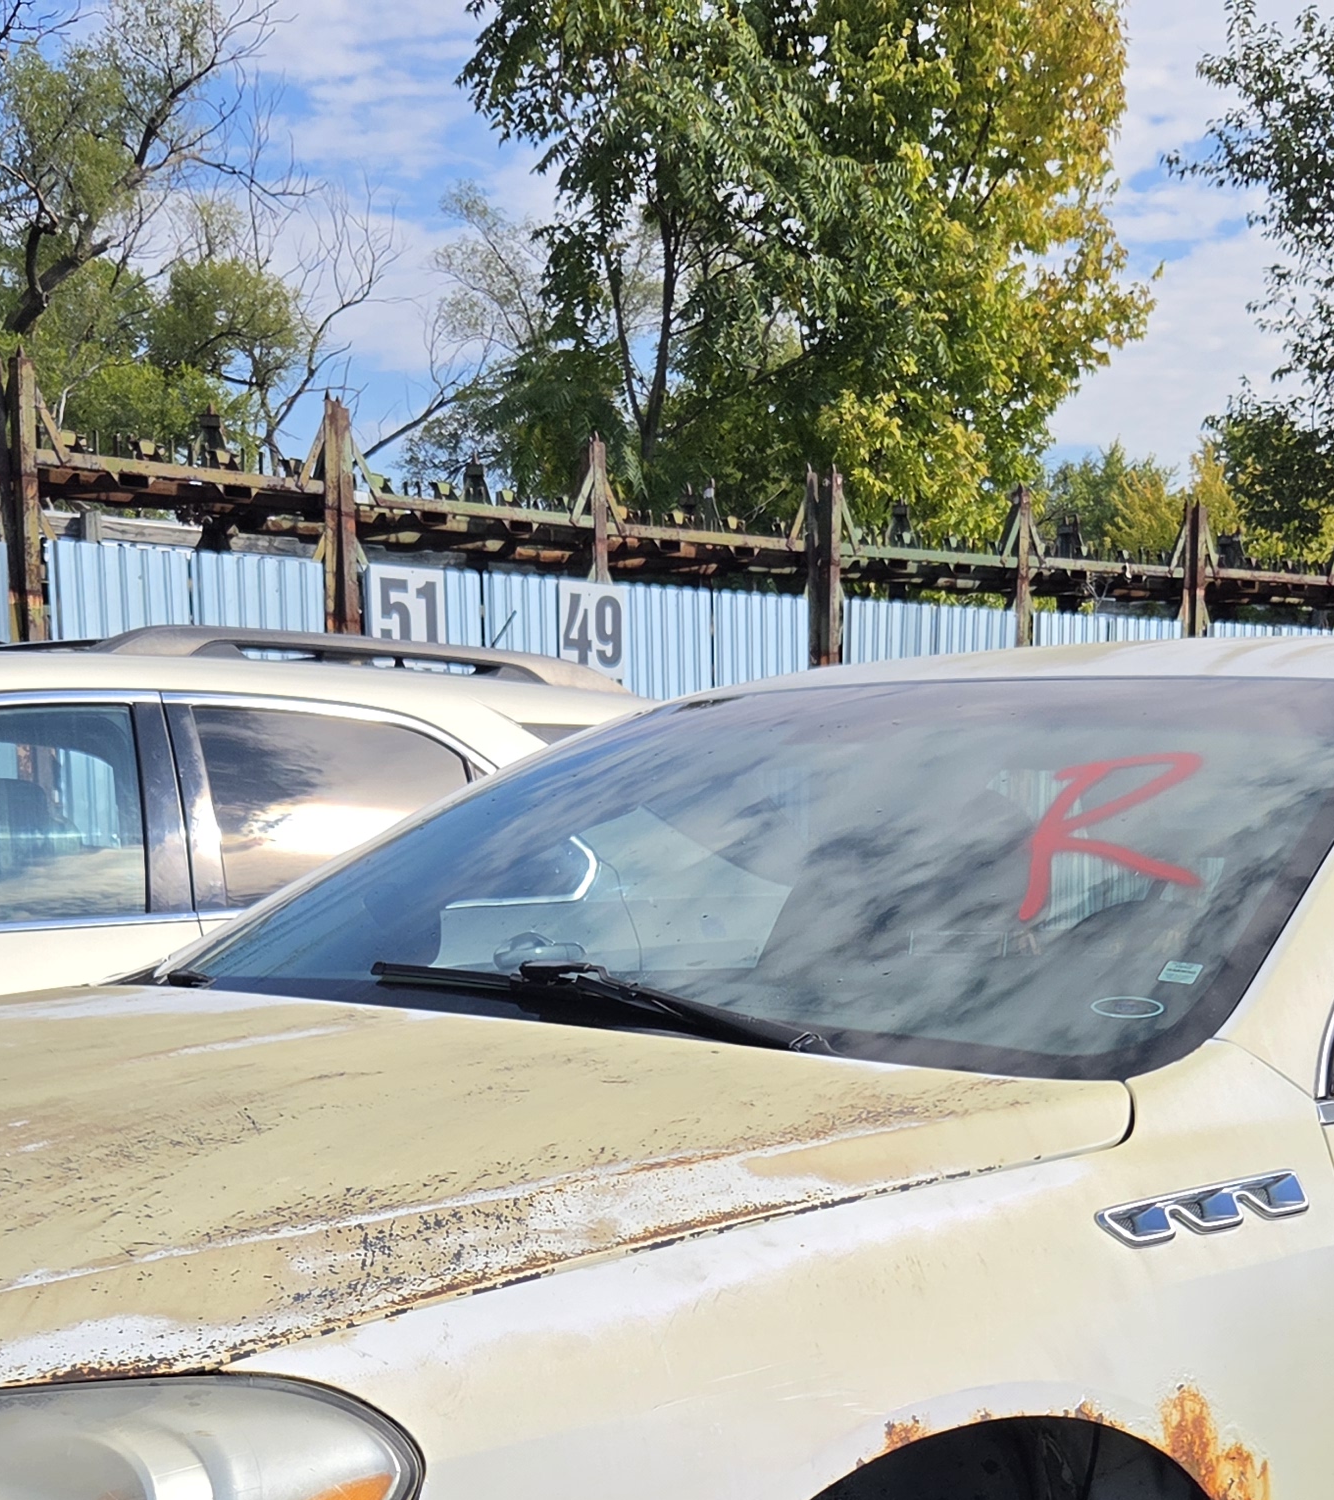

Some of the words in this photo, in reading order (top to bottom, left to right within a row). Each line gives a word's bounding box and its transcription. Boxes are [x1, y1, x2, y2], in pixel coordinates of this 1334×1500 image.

[380, 577, 438, 644] 51
[563, 592, 623, 668] 49
[1018, 751, 1204, 922] R
